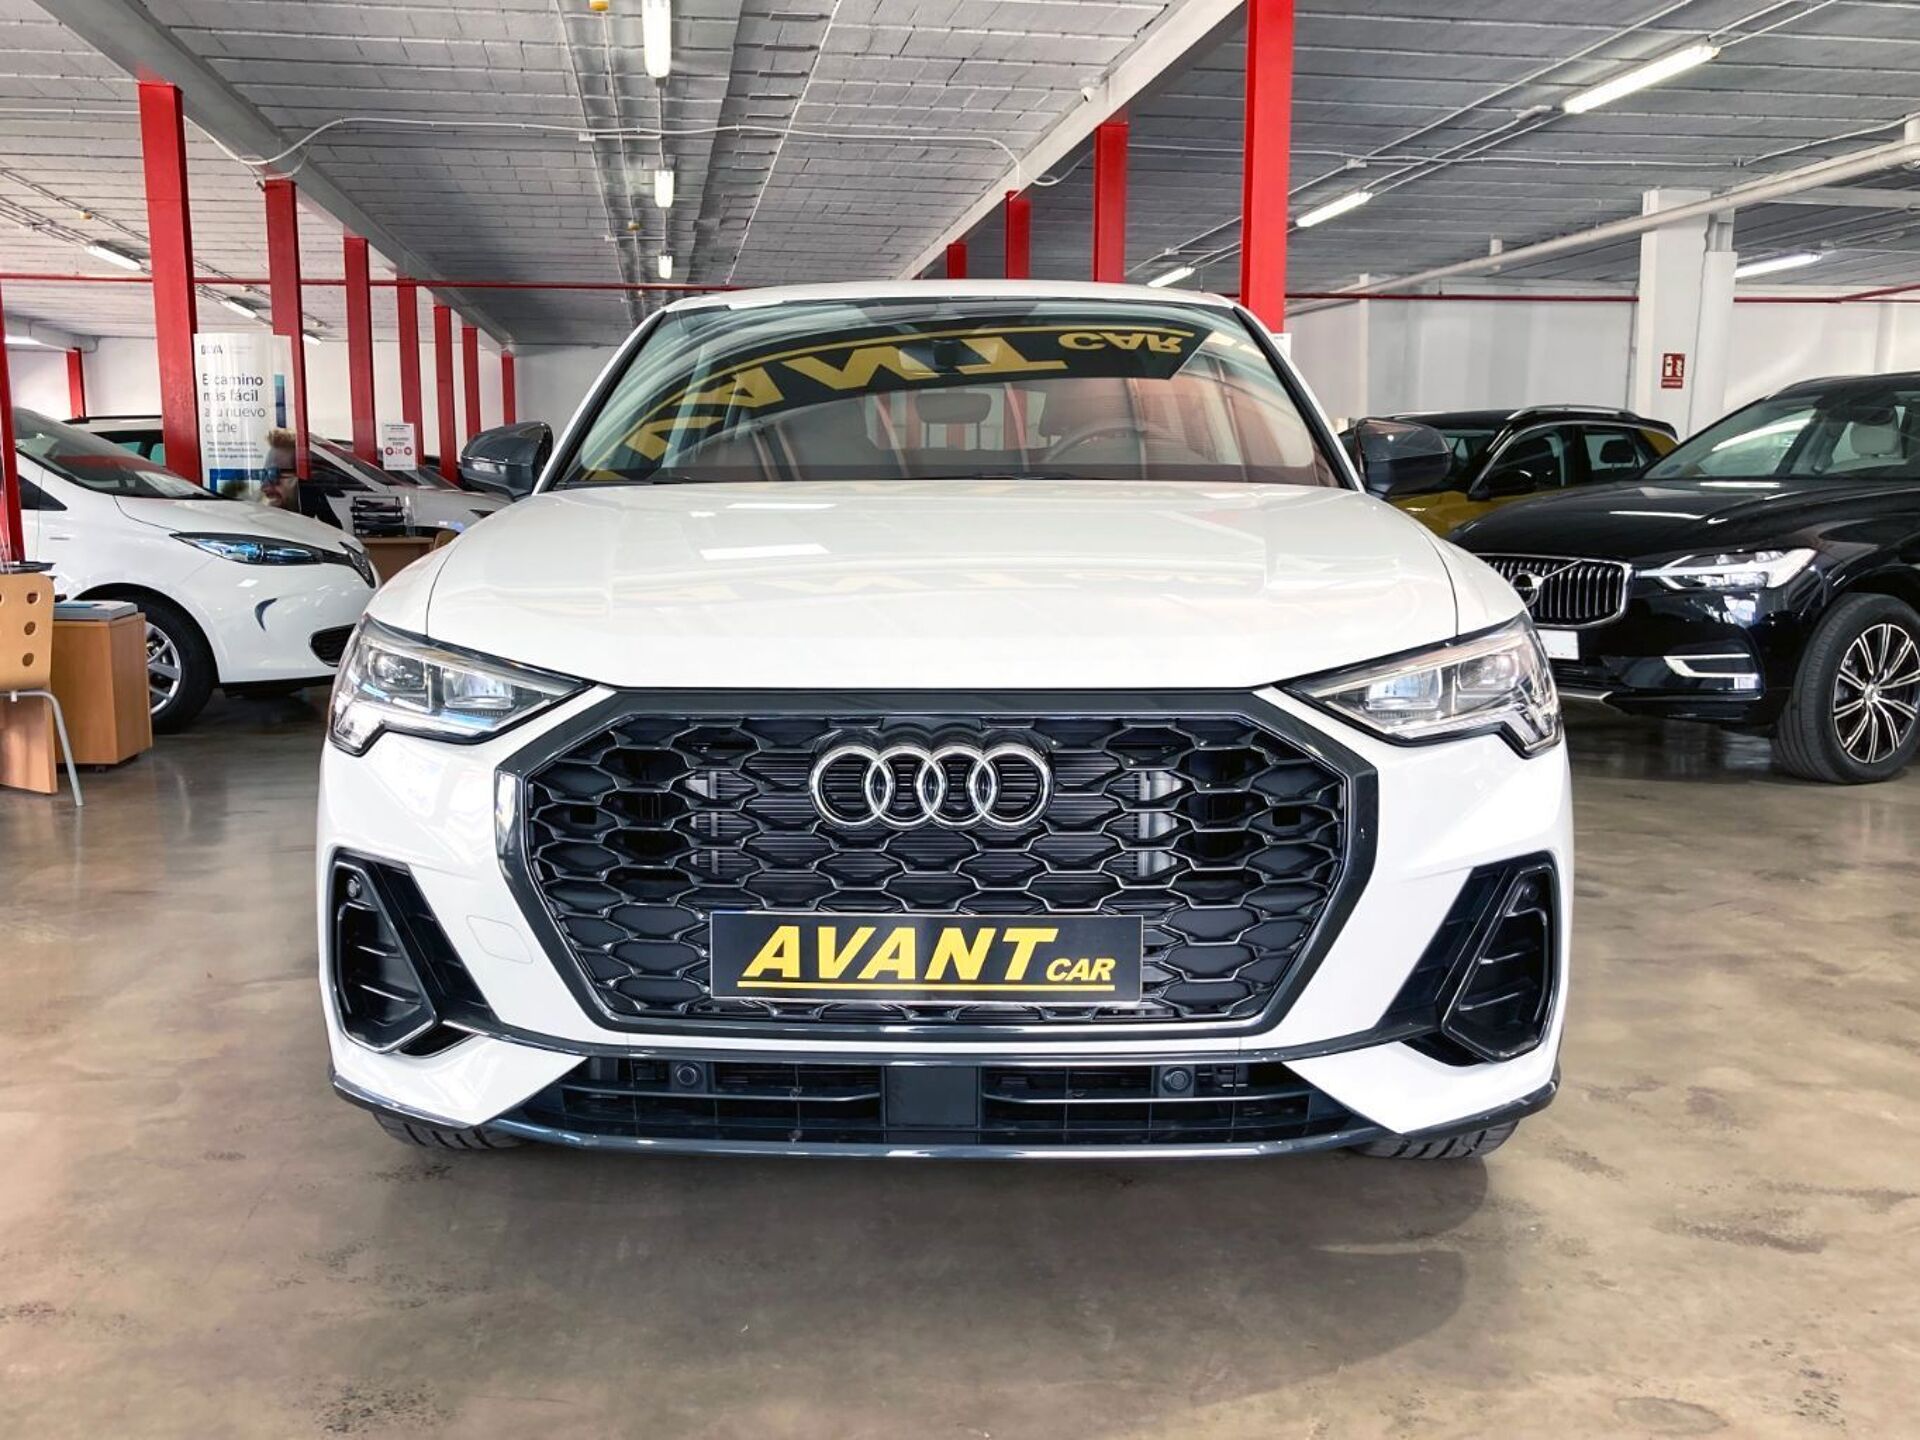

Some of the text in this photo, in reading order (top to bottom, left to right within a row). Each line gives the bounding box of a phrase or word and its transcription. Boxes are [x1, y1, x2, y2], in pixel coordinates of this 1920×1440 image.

[200, 344, 223, 355] BVA
[214, 373, 264, 386] camino
[742, 926, 1116, 982] AVANT CAR
